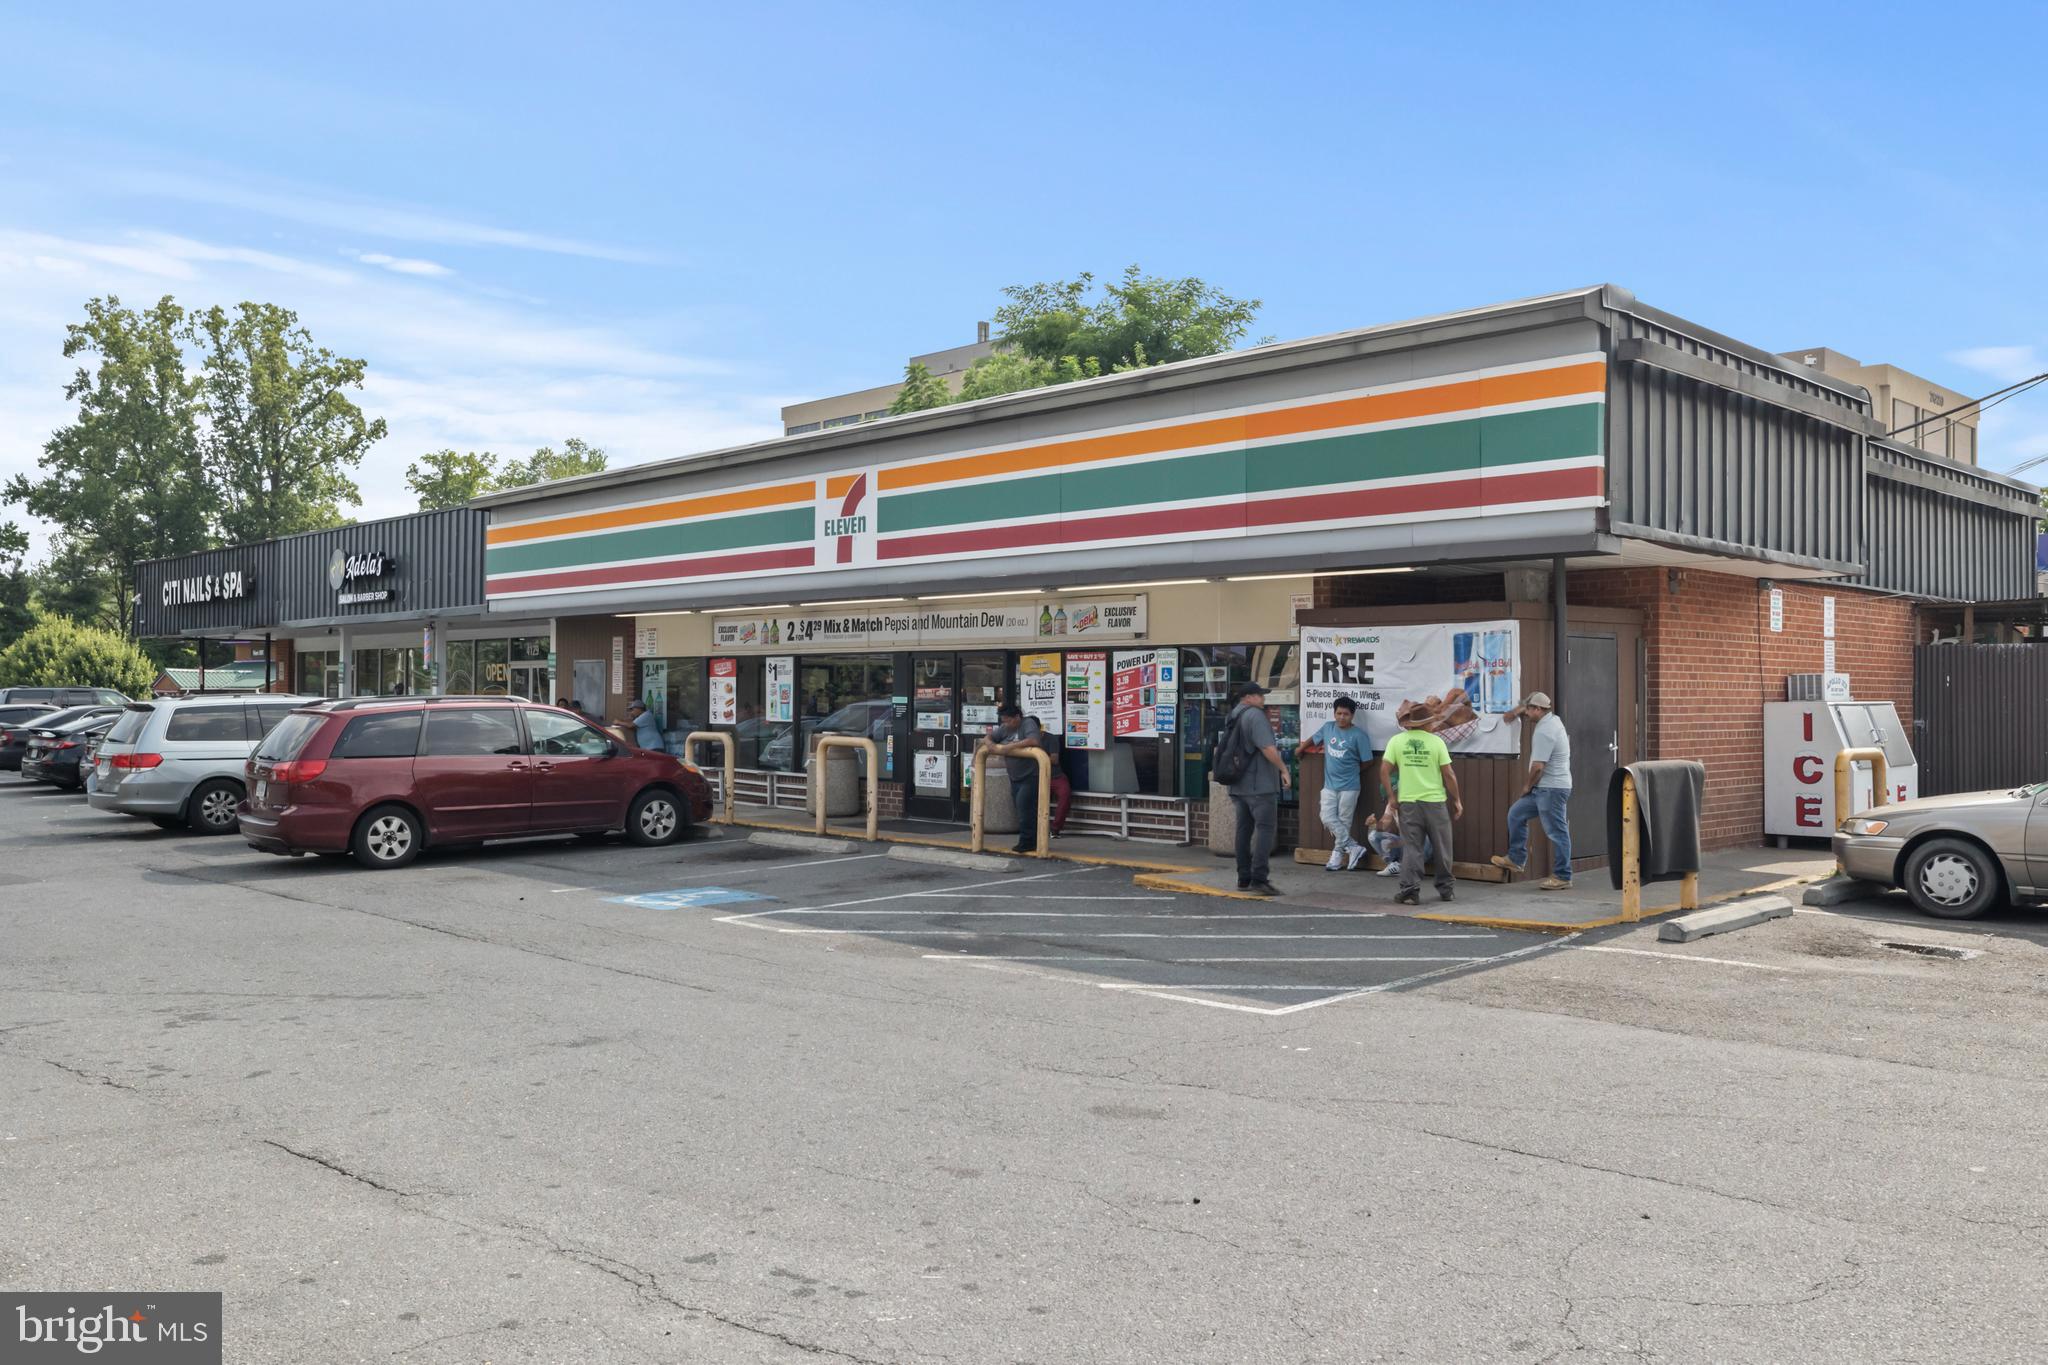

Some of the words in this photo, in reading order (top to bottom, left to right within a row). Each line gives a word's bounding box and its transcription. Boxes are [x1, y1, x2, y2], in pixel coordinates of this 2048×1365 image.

[837, 472, 867, 564] 7
[346, 551, 383, 581] Adela's
[162, 580, 181, 606] CITI
[183, 574, 212, 603] NAILS
[214, 577, 220, 597] &
[223, 571, 243, 599] SPA
[357, 592, 375, 602] BARBER
[375, 591, 388, 600] SHOP
[1104, 606, 1137, 617] EXCLUSIVE
[718, 625, 738, 634] EXCLUSIVE
[787, 622, 795, 641] 2
[823, 619, 841, 633] Mix
[842, 618, 850, 632] &
[851, 617, 883, 632] Match
[884, 616, 910, 634] Pepsi
[912, 615, 929, 630] and
[931, 612, 978, 629] Mountain
[981, 612, 1004, 628] Dew
[1107, 618, 1131, 628] FLAVOR
[720, 634, 735, 642] FLAVOR
[1116, 656, 1141, 671] POWER
[1142, 653, 1155, 664] UP
[1306, 652, 1375, 684] FREE
[485, 663, 512, 682] OPEN
[768, 662, 778, 681] $1
[1035, 680, 1056, 690] FREE
[1306, 689, 1332, 698] 5-Piece
[1332, 689, 1359, 698] Bone-In
[1359, 691, 1381, 701] Wings
[1307, 701, 1324, 709] when
[1370, 702, 1385, 711] Bull
[1793, 712, 1824, 828] ICE
